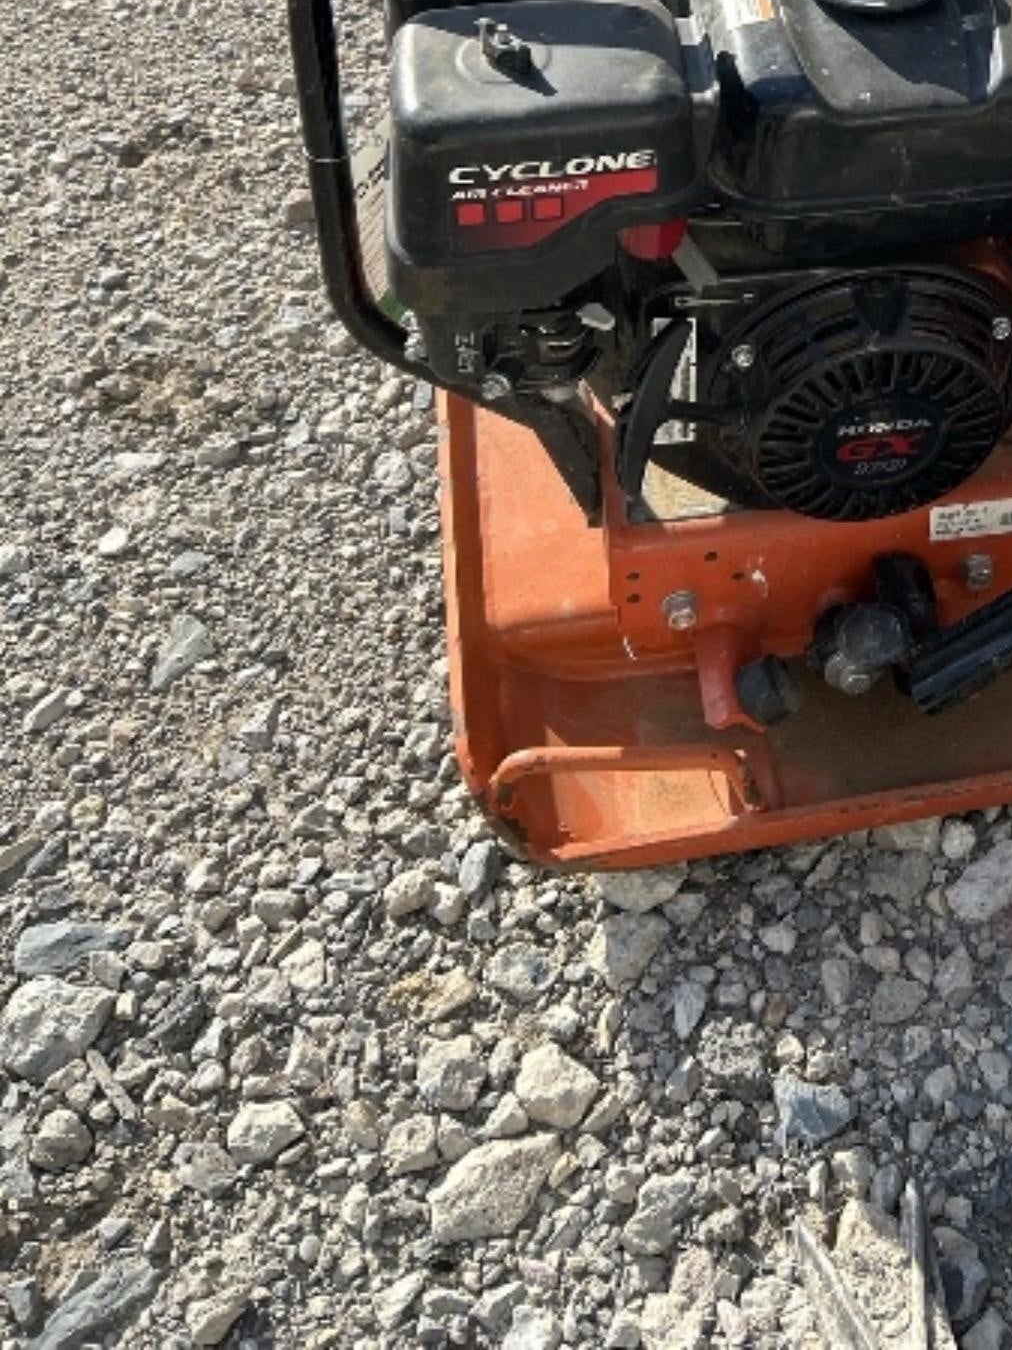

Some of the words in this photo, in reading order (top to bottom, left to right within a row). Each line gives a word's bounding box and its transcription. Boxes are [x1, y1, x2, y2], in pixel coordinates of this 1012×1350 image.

[449, 149, 657, 184] CYCLONE
[836, 418, 934, 437] HONDA
[836, 433, 922, 463] GX
